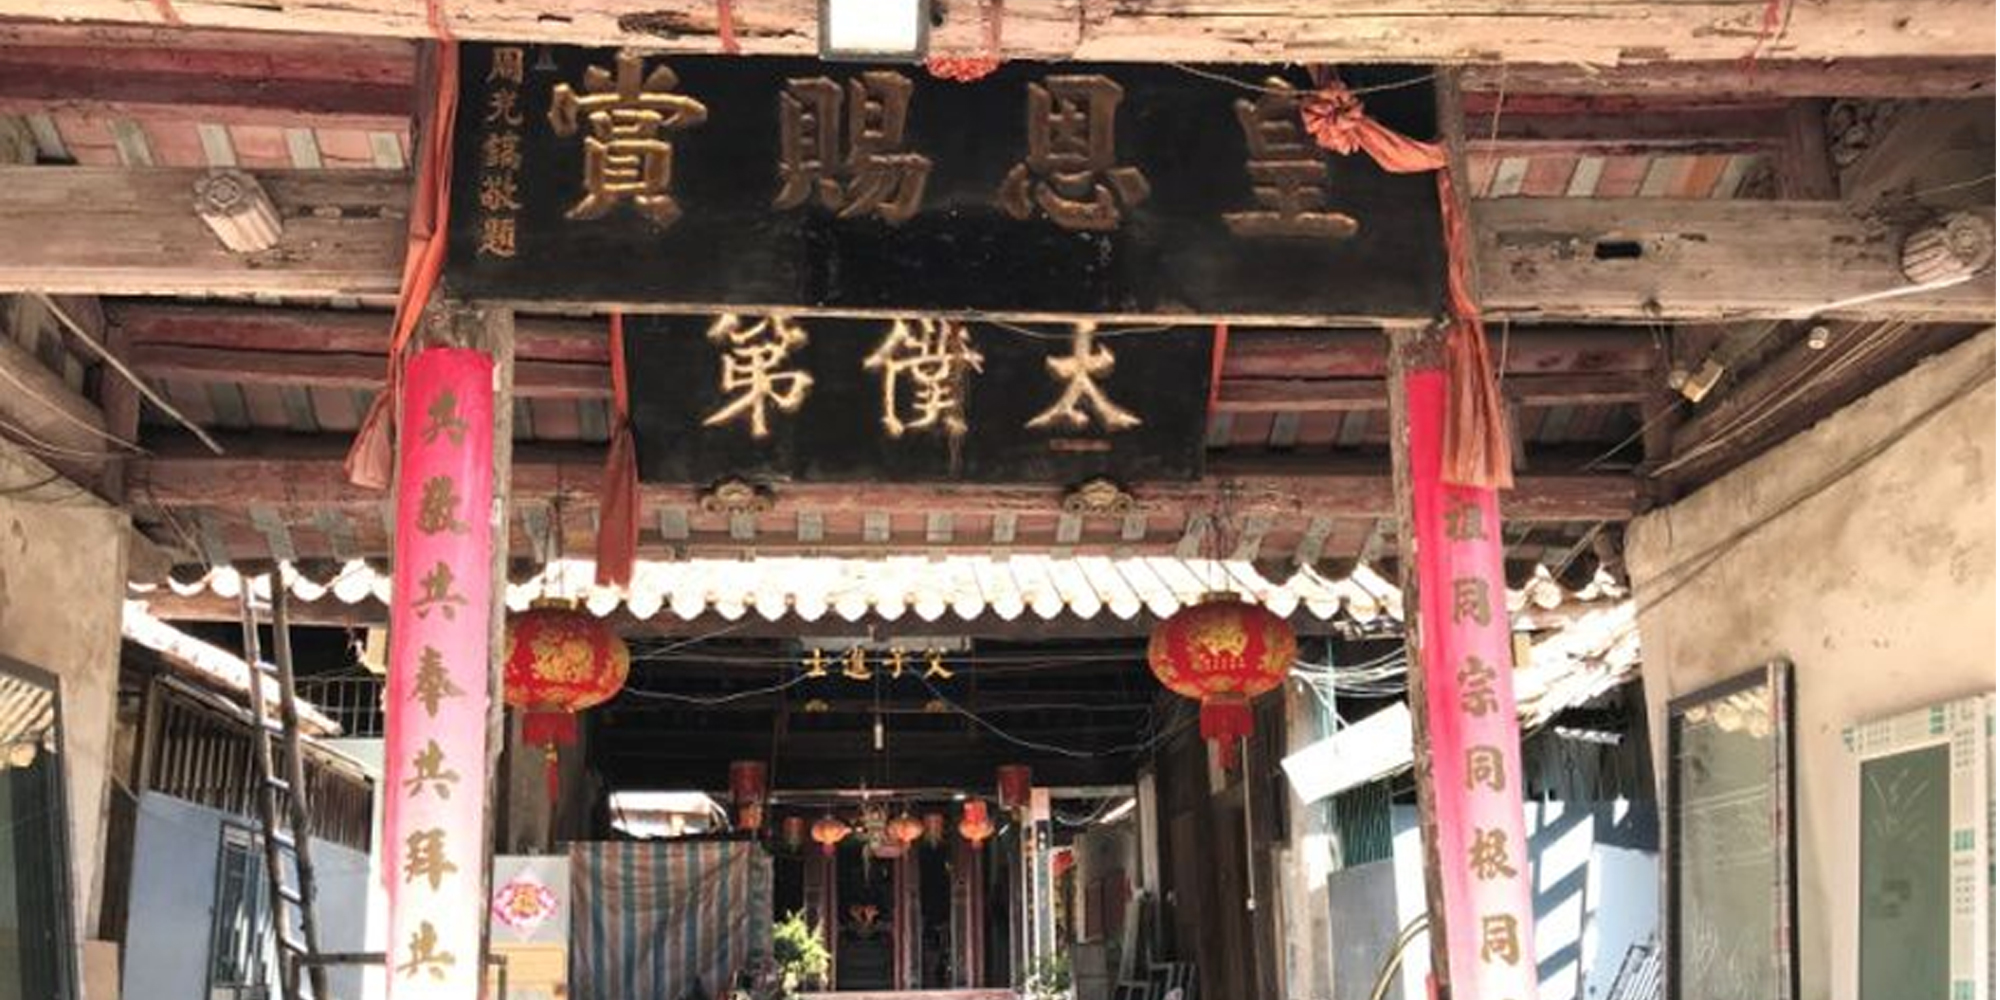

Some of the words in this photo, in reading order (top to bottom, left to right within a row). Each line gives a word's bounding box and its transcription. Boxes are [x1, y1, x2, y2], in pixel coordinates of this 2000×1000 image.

[1442, 493, 1522, 1000] 祖同宗同根同
